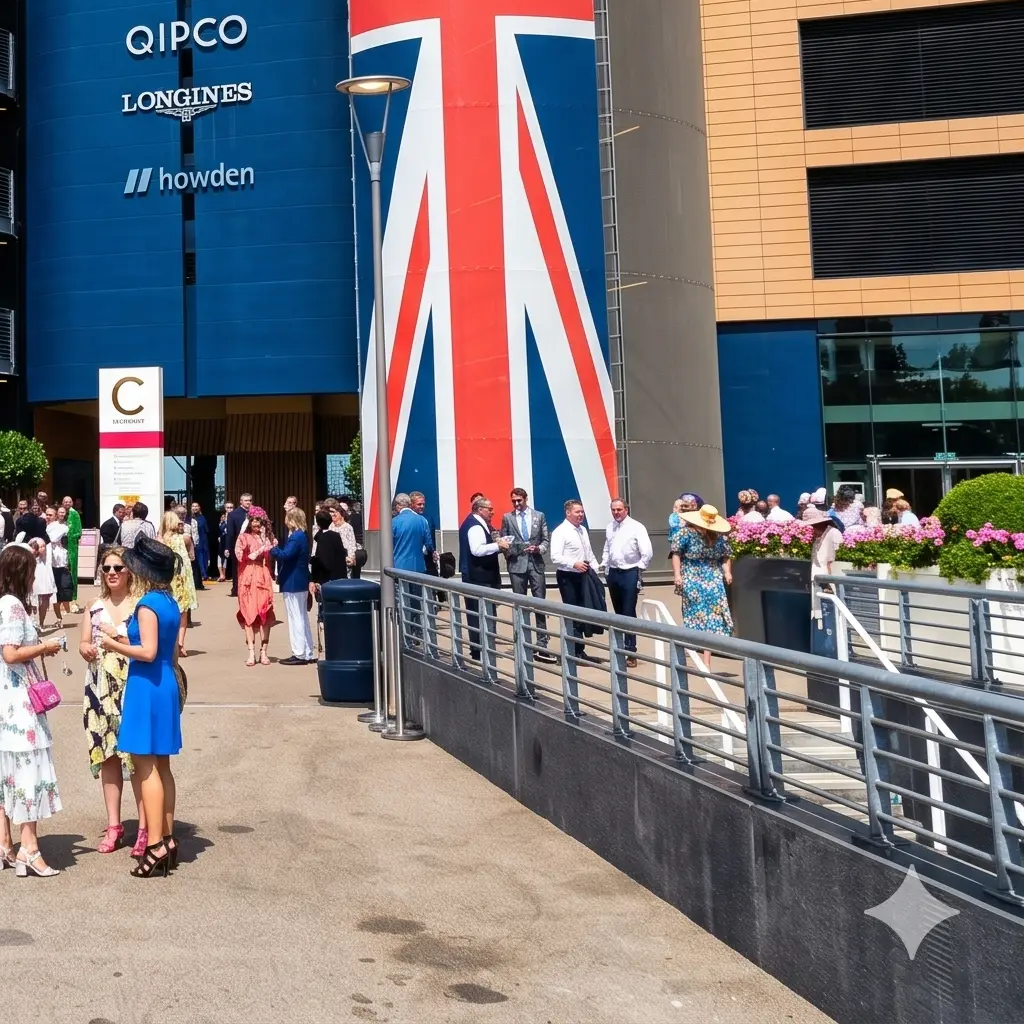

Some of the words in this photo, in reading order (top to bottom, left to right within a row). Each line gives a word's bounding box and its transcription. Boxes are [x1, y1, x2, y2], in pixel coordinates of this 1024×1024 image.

[126, 14, 248, 55] QIPCO
[121, 82, 253, 113] LONGINES
[159, 162, 255, 191] howden
[112, 376, 144, 416] C
